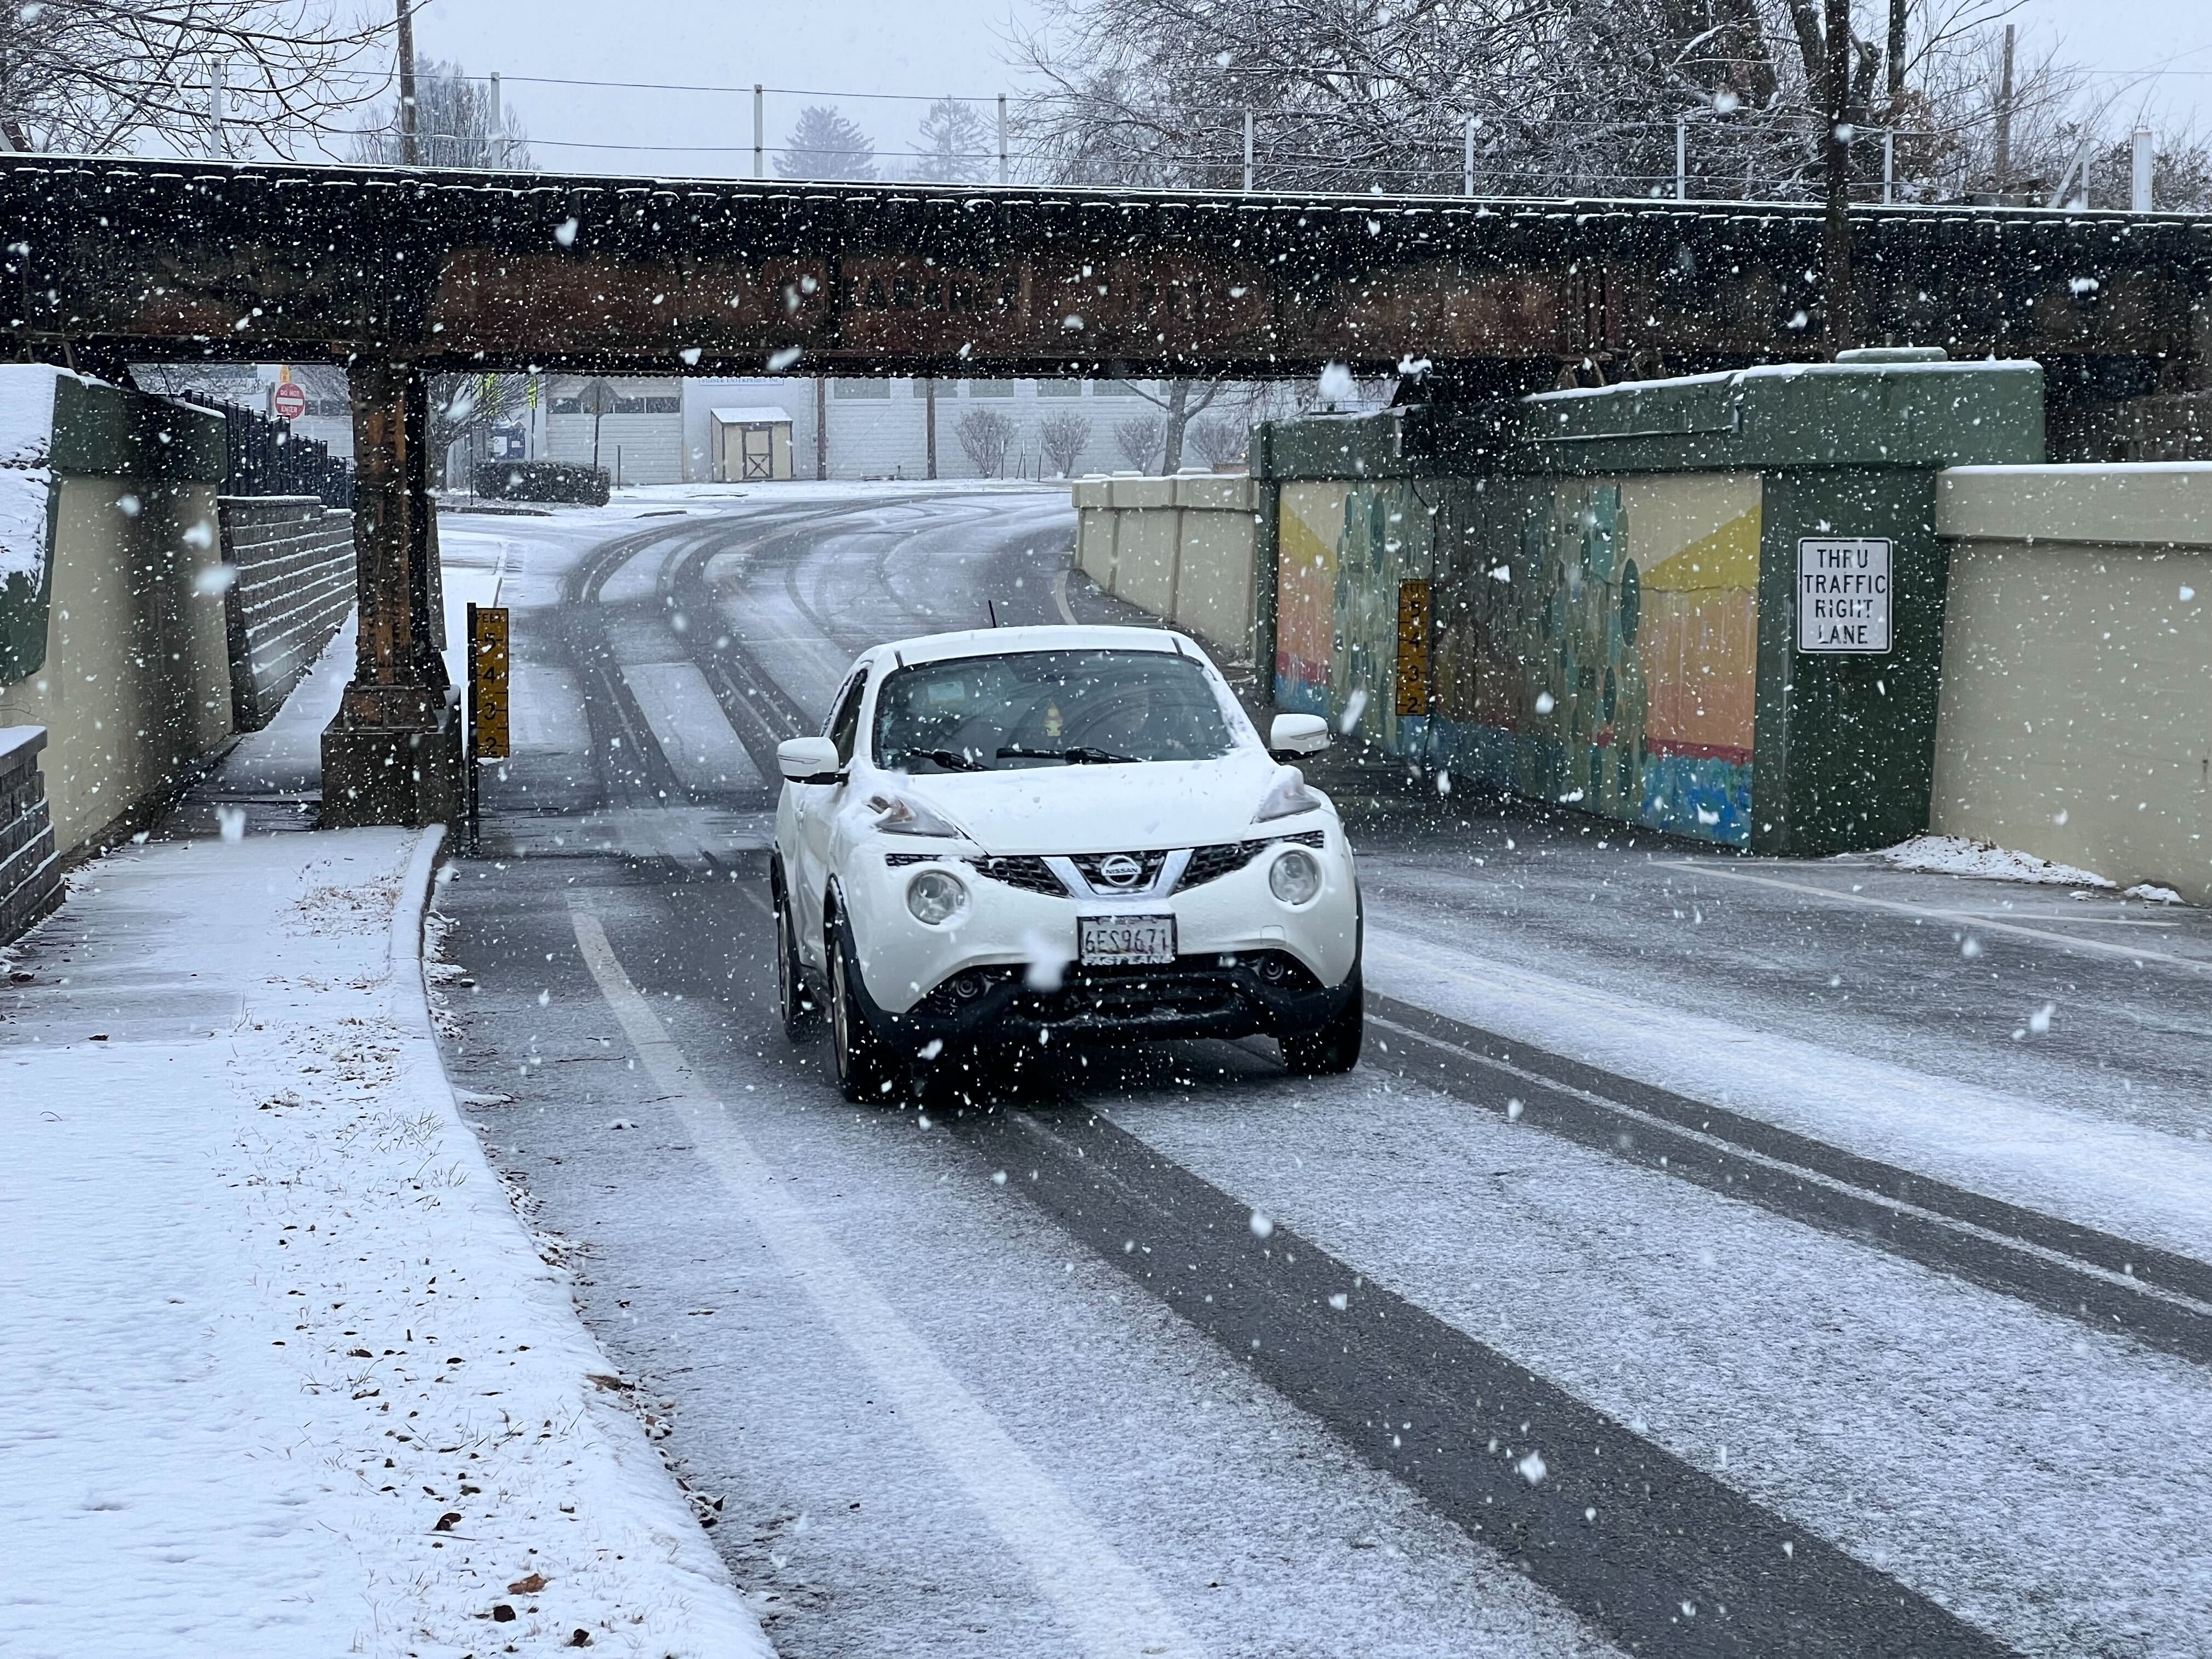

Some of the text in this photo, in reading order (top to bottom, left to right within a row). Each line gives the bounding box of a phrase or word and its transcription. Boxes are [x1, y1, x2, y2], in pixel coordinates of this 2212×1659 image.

[1816, 549, 1868, 568] THRU
[1804, 574, 1886, 594] TRAFFIC
[1410, 601, 1421, 618] 5
[1815, 599, 1874, 618] RIGHT
[484, 632, 496, 651] 5
[1408, 631, 1420, 649] 4
[1818, 625, 1868, 644] LANE
[482, 666, 496, 685] 4
[1408, 665, 1419, 682] 3
[483, 702, 496, 721] 3
[1407, 697, 1418, 713] 2
[484, 736, 497, 755] 2
